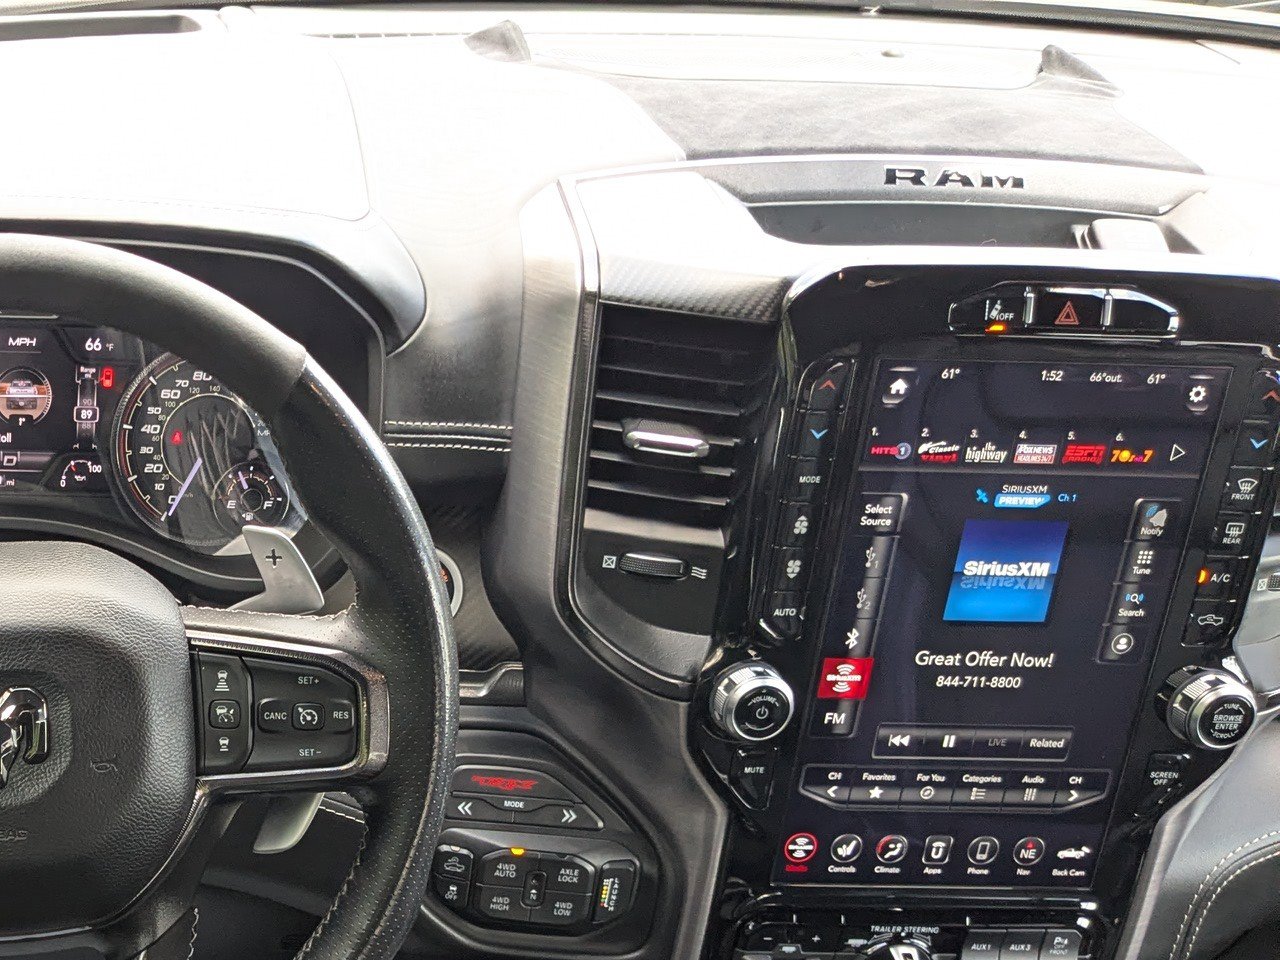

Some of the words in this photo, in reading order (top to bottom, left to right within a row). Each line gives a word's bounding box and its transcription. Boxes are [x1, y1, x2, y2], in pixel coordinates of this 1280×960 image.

[884, 168, 1024, 188] RAM
[8, 338, 36, 347] MPH
[85, 338, 102, 351] 66
[941, 369, 960, 379] 61°
[1041, 371, 1063, 381] 1:52
[1147, 374, 1166, 384] 61°
[161, 389, 180, 399] 60
[80, 410, 92, 419] 89
[141, 425, 160, 433] 40
[965, 447, 1007, 463] highway
[1065, 446, 1105, 456] ESPN
[89, 465, 102, 473] 100
[144, 464, 163, 473] 20
[799, 476, 821, 484] MODE
[1002, 484, 1048, 494] SIRIUSXM
[998, 496, 1044, 506] PREVIEW
[1058, 494, 1070, 502] Ch
[1072, 494, 1076, 502] 1
[1231, 493, 1255, 501] FRONT
[227, 501, 236, 509] E
[263, 501, 273, 509] F
[865, 504, 892, 514] Select
[860, 516, 891, 526] Source
[1140, 527, 1163, 537] Notify
[963, 561, 1050, 577] SiriusXM
[1133, 567, 1151, 575] Tune
[1211, 574, 1230, 583] A/C
[864, 602, 870, 610] 2
[1118, 609, 1144, 617] Search
[915, 650, 960, 666] Great
[965, 652, 1007, 667] Offer
[1010, 653, 1054, 668] Now!
[936, 676, 1021, 688] 844-711-8800
[752, 695, 776, 703] VOLUME
[264, 712, 287, 720] CANC
[333, 711, 349, 719] RES
[824, 713, 845, 724] FM
[1030, 739, 1065, 748] Related
[828, 772, 842, 780] CH
[862, 773, 896, 781] Favorites
[917, 774, 929, 782] For
[930, 774, 946, 782] You
[963, 774, 1002, 784] Categories
[1022, 775, 1045, 784] Audio
[1020, 849, 1036, 859] NE
[497, 863, 516, 871] 4WD
[828, 865, 857, 873] Controls
[874, 866, 901, 874] Climate
[923, 867, 942, 875] Apps
[967, 867, 989, 875] Phone
[494, 870, 516, 878] AUTO
[559, 868, 579, 876] AXLE
[558, 875, 578, 883] LOCK
[445, 892, 458, 900] OFF
[492, 897, 510, 905] 4WD
[490, 903, 509, 911] HIGH
[555, 901, 573, 910] 4WD
[554, 908, 571, 916] LOW
[904, 926, 939, 934] STEERING
